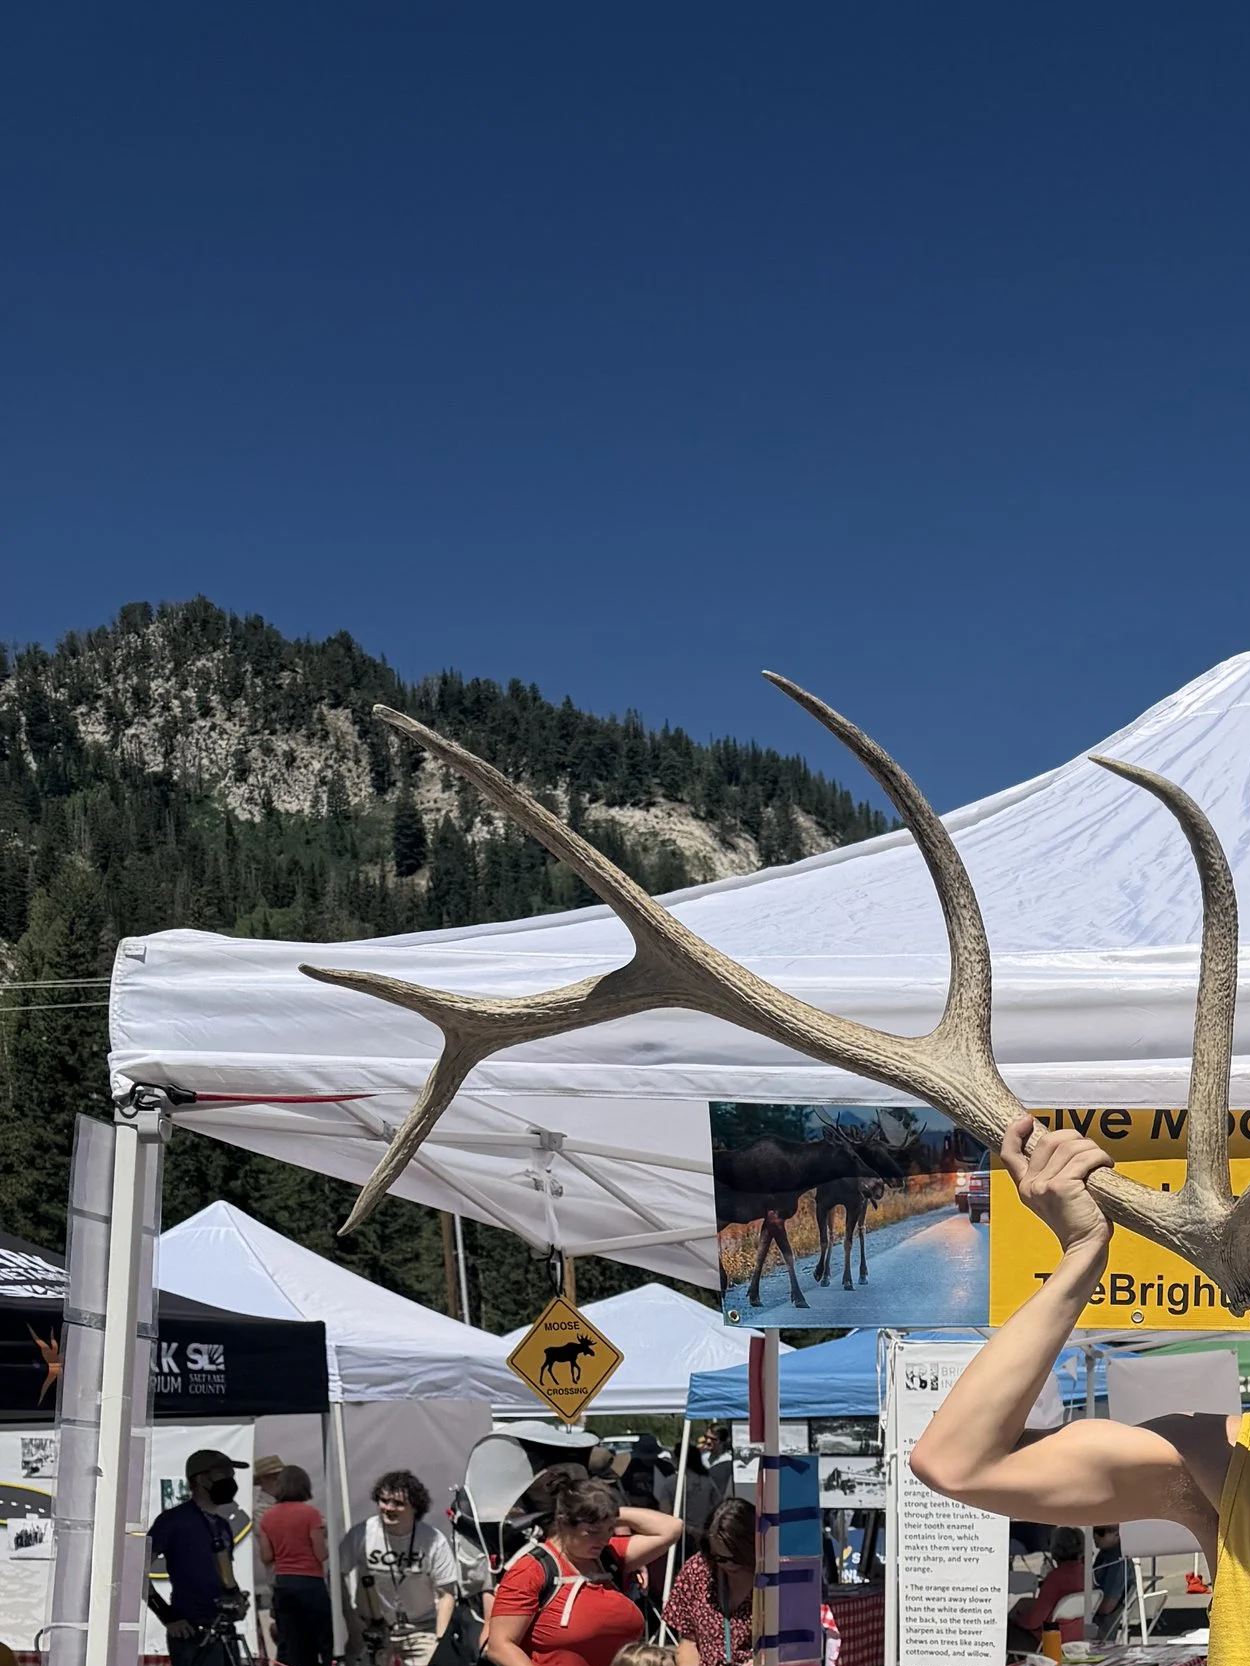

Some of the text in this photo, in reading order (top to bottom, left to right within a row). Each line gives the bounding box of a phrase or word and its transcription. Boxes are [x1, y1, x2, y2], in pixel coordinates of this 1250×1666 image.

[544, 1321, 580, 1331] MOOSE
[188, 1383, 227, 1394] COUNTY
[546, 1386, 589, 1397] CROSSING
[910, 1583, 924, 1591] The
[925, 1585, 950, 1593] orange
[905, 1594, 923, 1602] front
[919, 1616, 938, 1624] back,
[905, 1626, 934, 1635] sharpen
[958, 1628, 983, 1636] beaver
[905, 1637, 928, 1645] chews
[905, 1649, 950, 1657] cottonwood,
[967, 1650, 992, 1658] willow.
